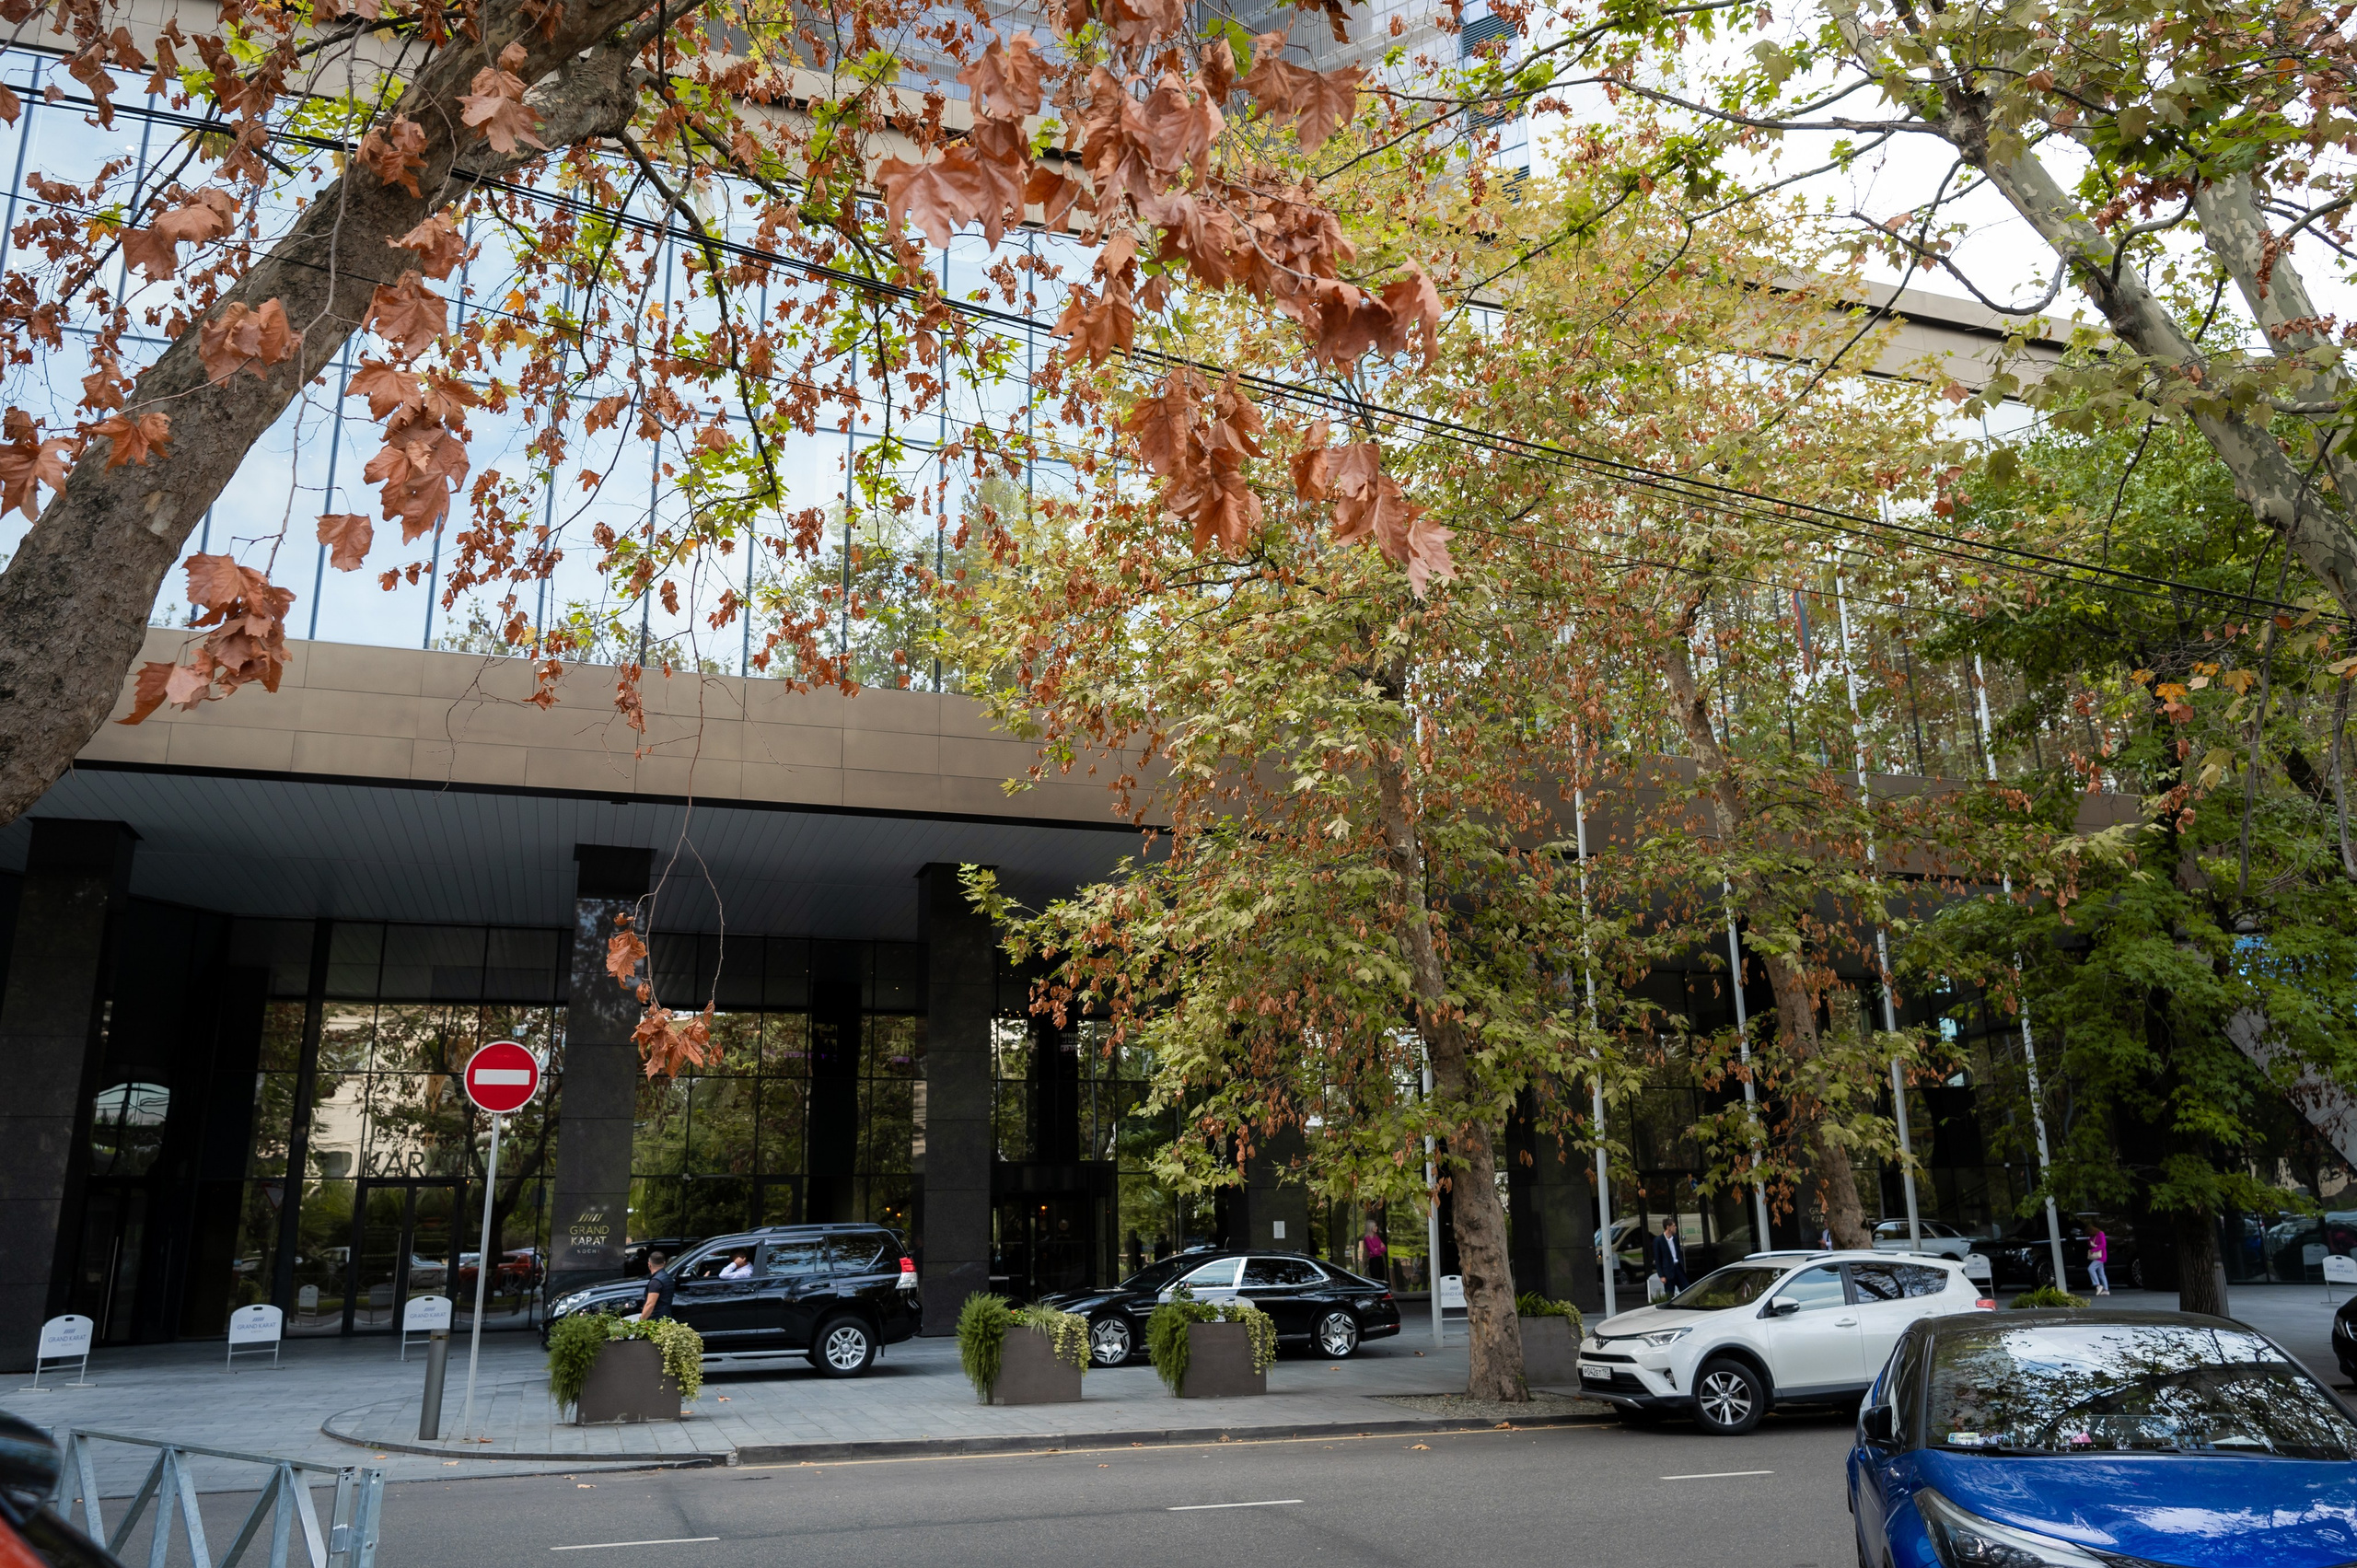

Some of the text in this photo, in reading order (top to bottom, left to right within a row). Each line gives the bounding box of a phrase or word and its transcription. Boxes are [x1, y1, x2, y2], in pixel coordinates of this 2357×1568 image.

[569, 1225, 610, 1235] GRAND
[571, 1236, 607, 1246] KARAT
[48, 1335, 68, 1343] GRAND
